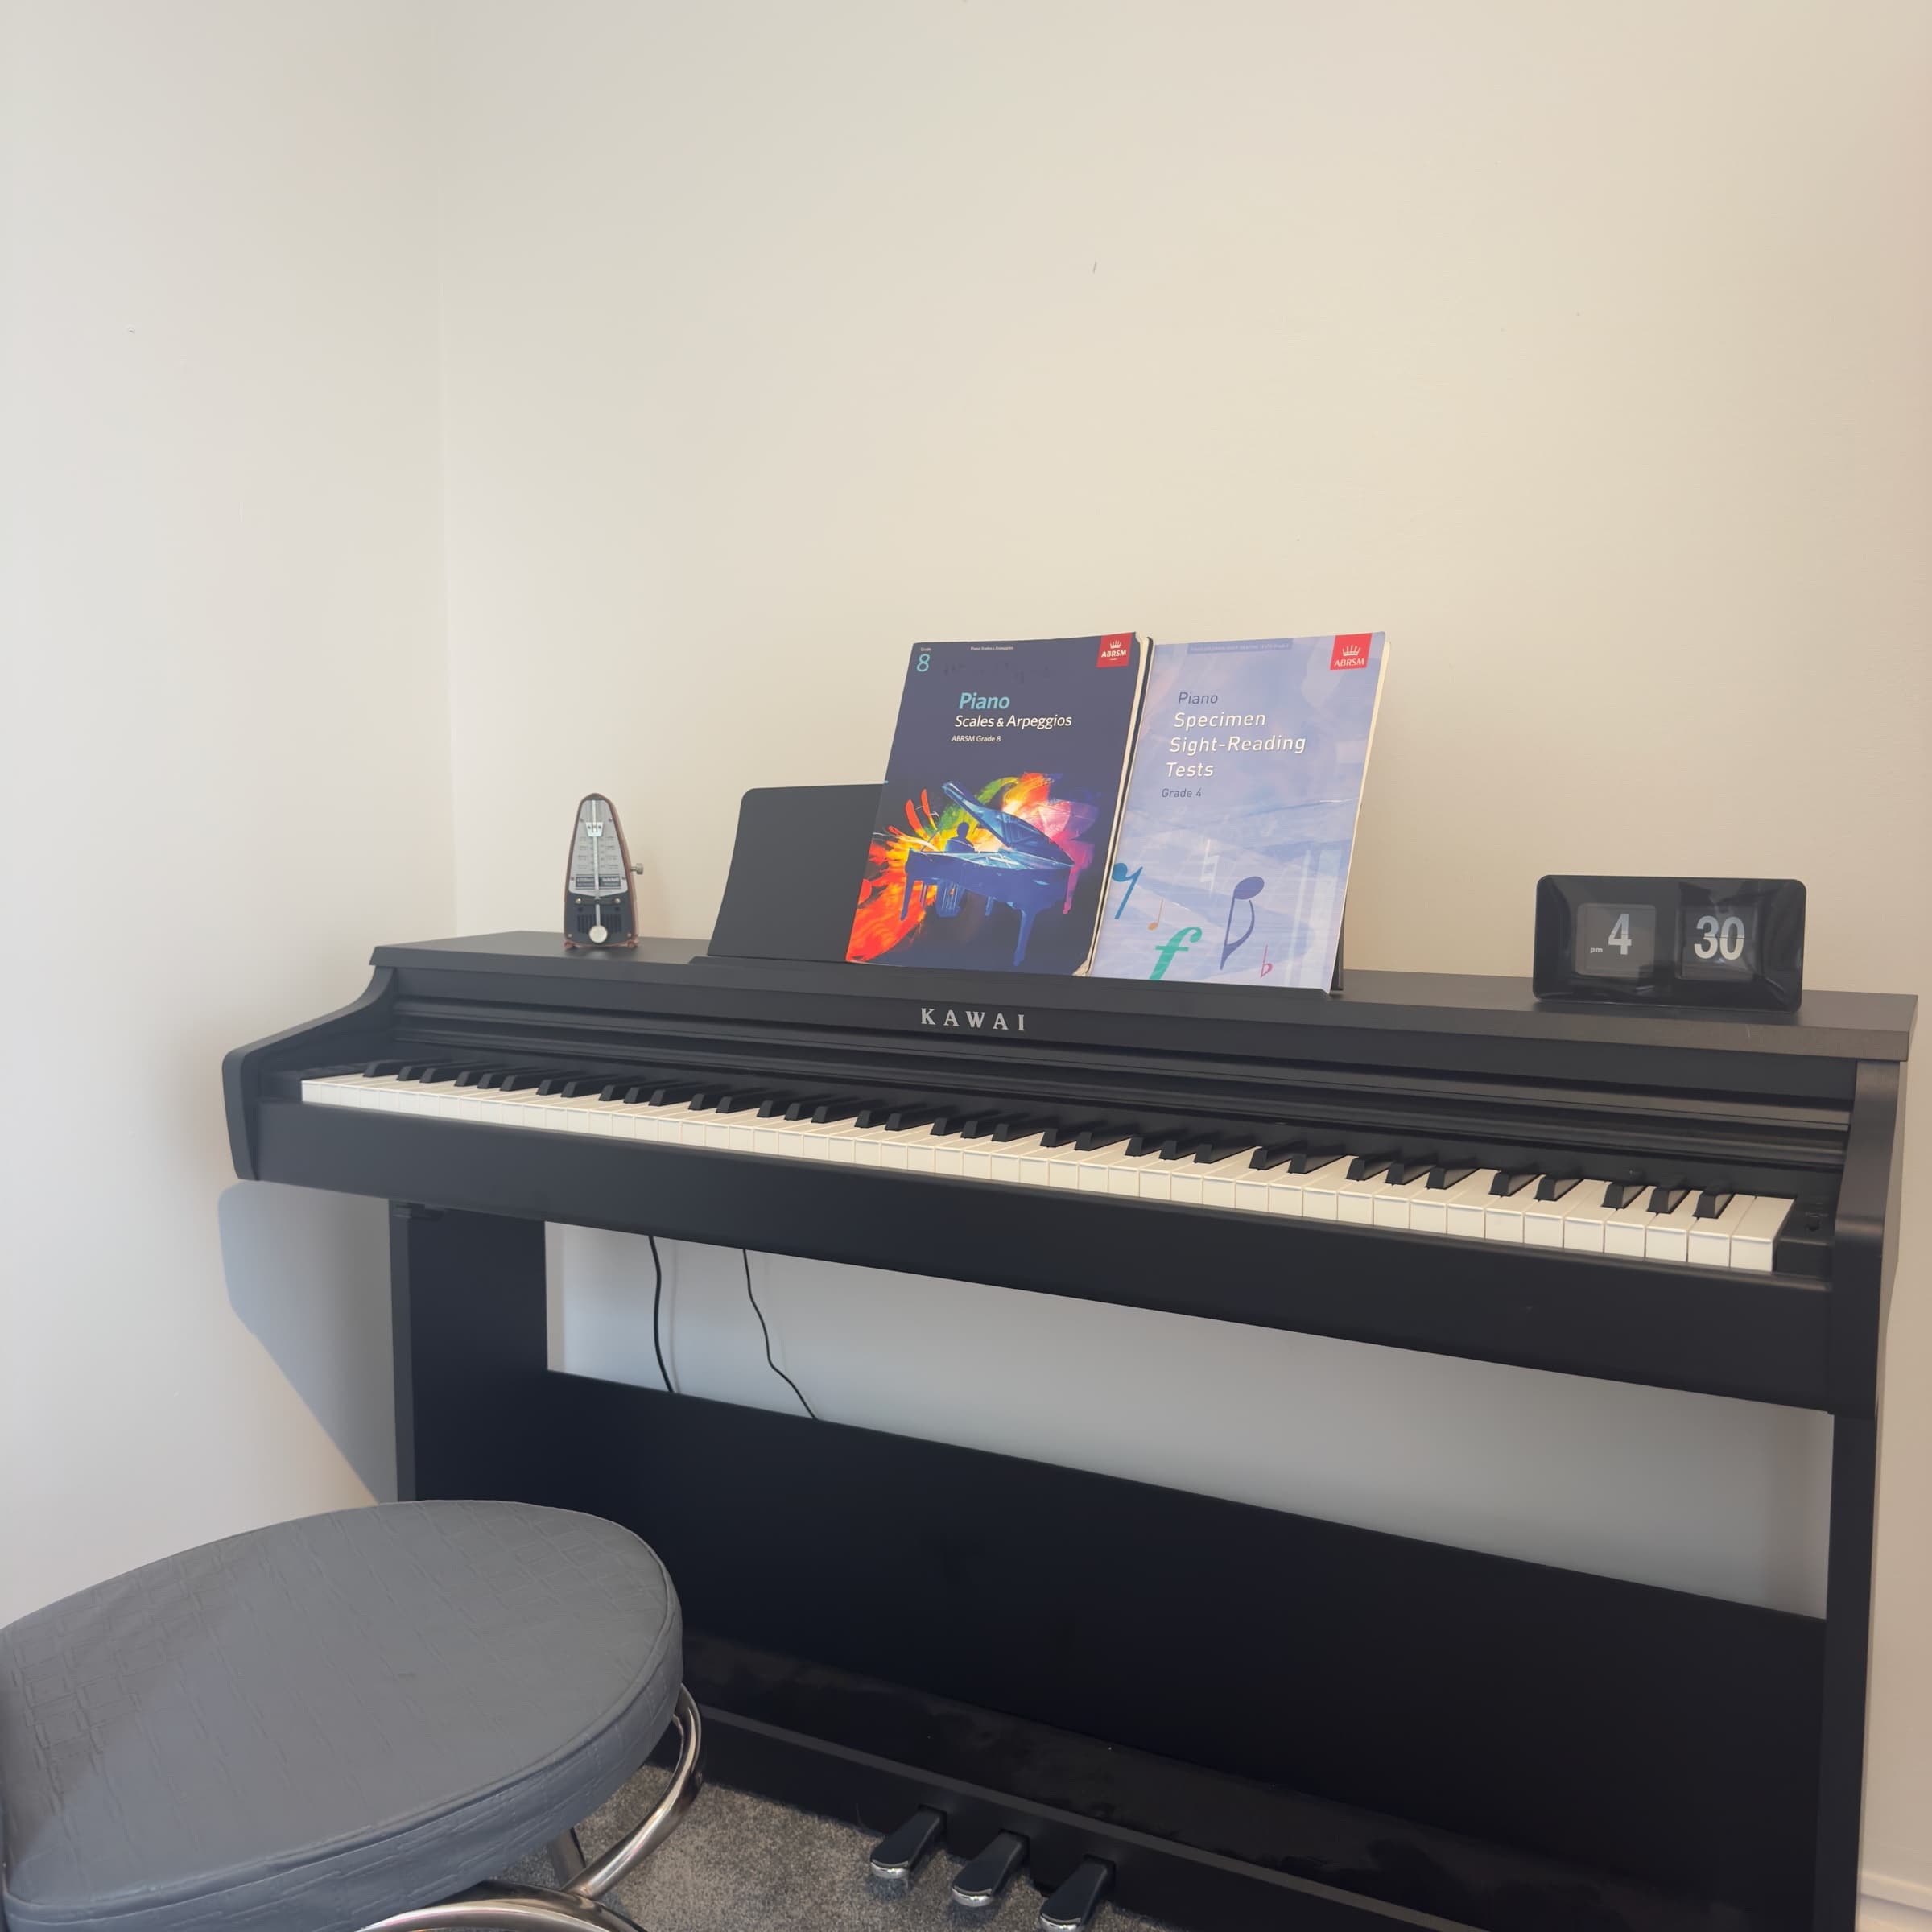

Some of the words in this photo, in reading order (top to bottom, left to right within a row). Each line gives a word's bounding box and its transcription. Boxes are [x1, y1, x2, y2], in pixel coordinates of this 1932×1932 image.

[1101, 650, 1127, 658] ABRSM
[1334, 658, 1364, 667] ABRSM
[916, 654, 931, 672] 8
[959, 692, 1010, 709] Piano
[1178, 691, 1219, 704] Piano
[955, 715, 994, 728] Scales
[996, 717, 1004, 727] &
[1006, 714, 1072, 729] Arpeggios
[1174, 712, 1265, 731] Specimen
[1169, 735, 1306, 756] Sight-Reading
[1166, 762, 1214, 778] Tests
[1162, 788, 1192, 798] Grade
[1195, 788, 1202, 797] 4
[1608, 914, 1632, 955] 4
[1694, 915, 1746, 960] 30
[921, 1008, 1025, 1031] KAWAI
